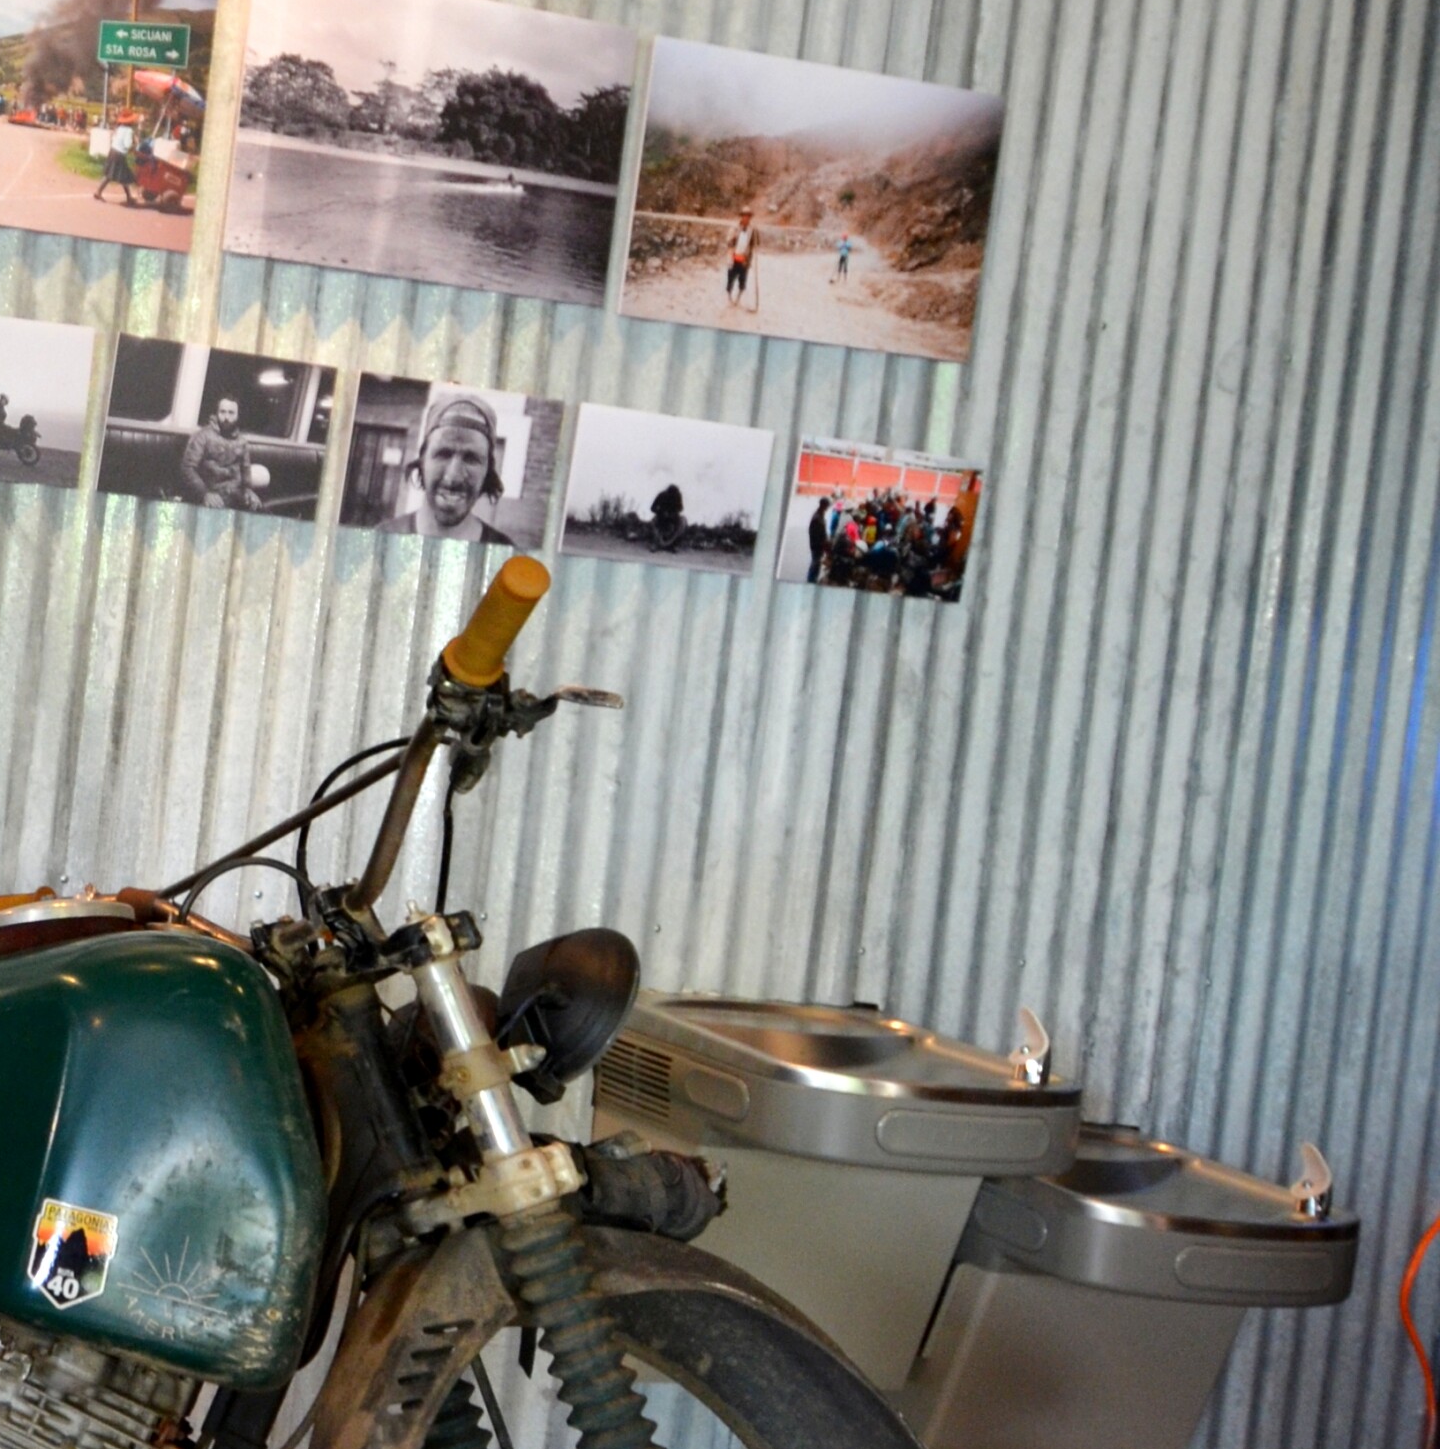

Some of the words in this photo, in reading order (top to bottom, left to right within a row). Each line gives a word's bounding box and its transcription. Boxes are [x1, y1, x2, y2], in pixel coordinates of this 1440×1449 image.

[130, 29, 173, 42] SICUANI
[106, 45, 124, 56] STA
[128, 45, 157, 59] ROSA
[47, 1275, 80, 1299] 40
